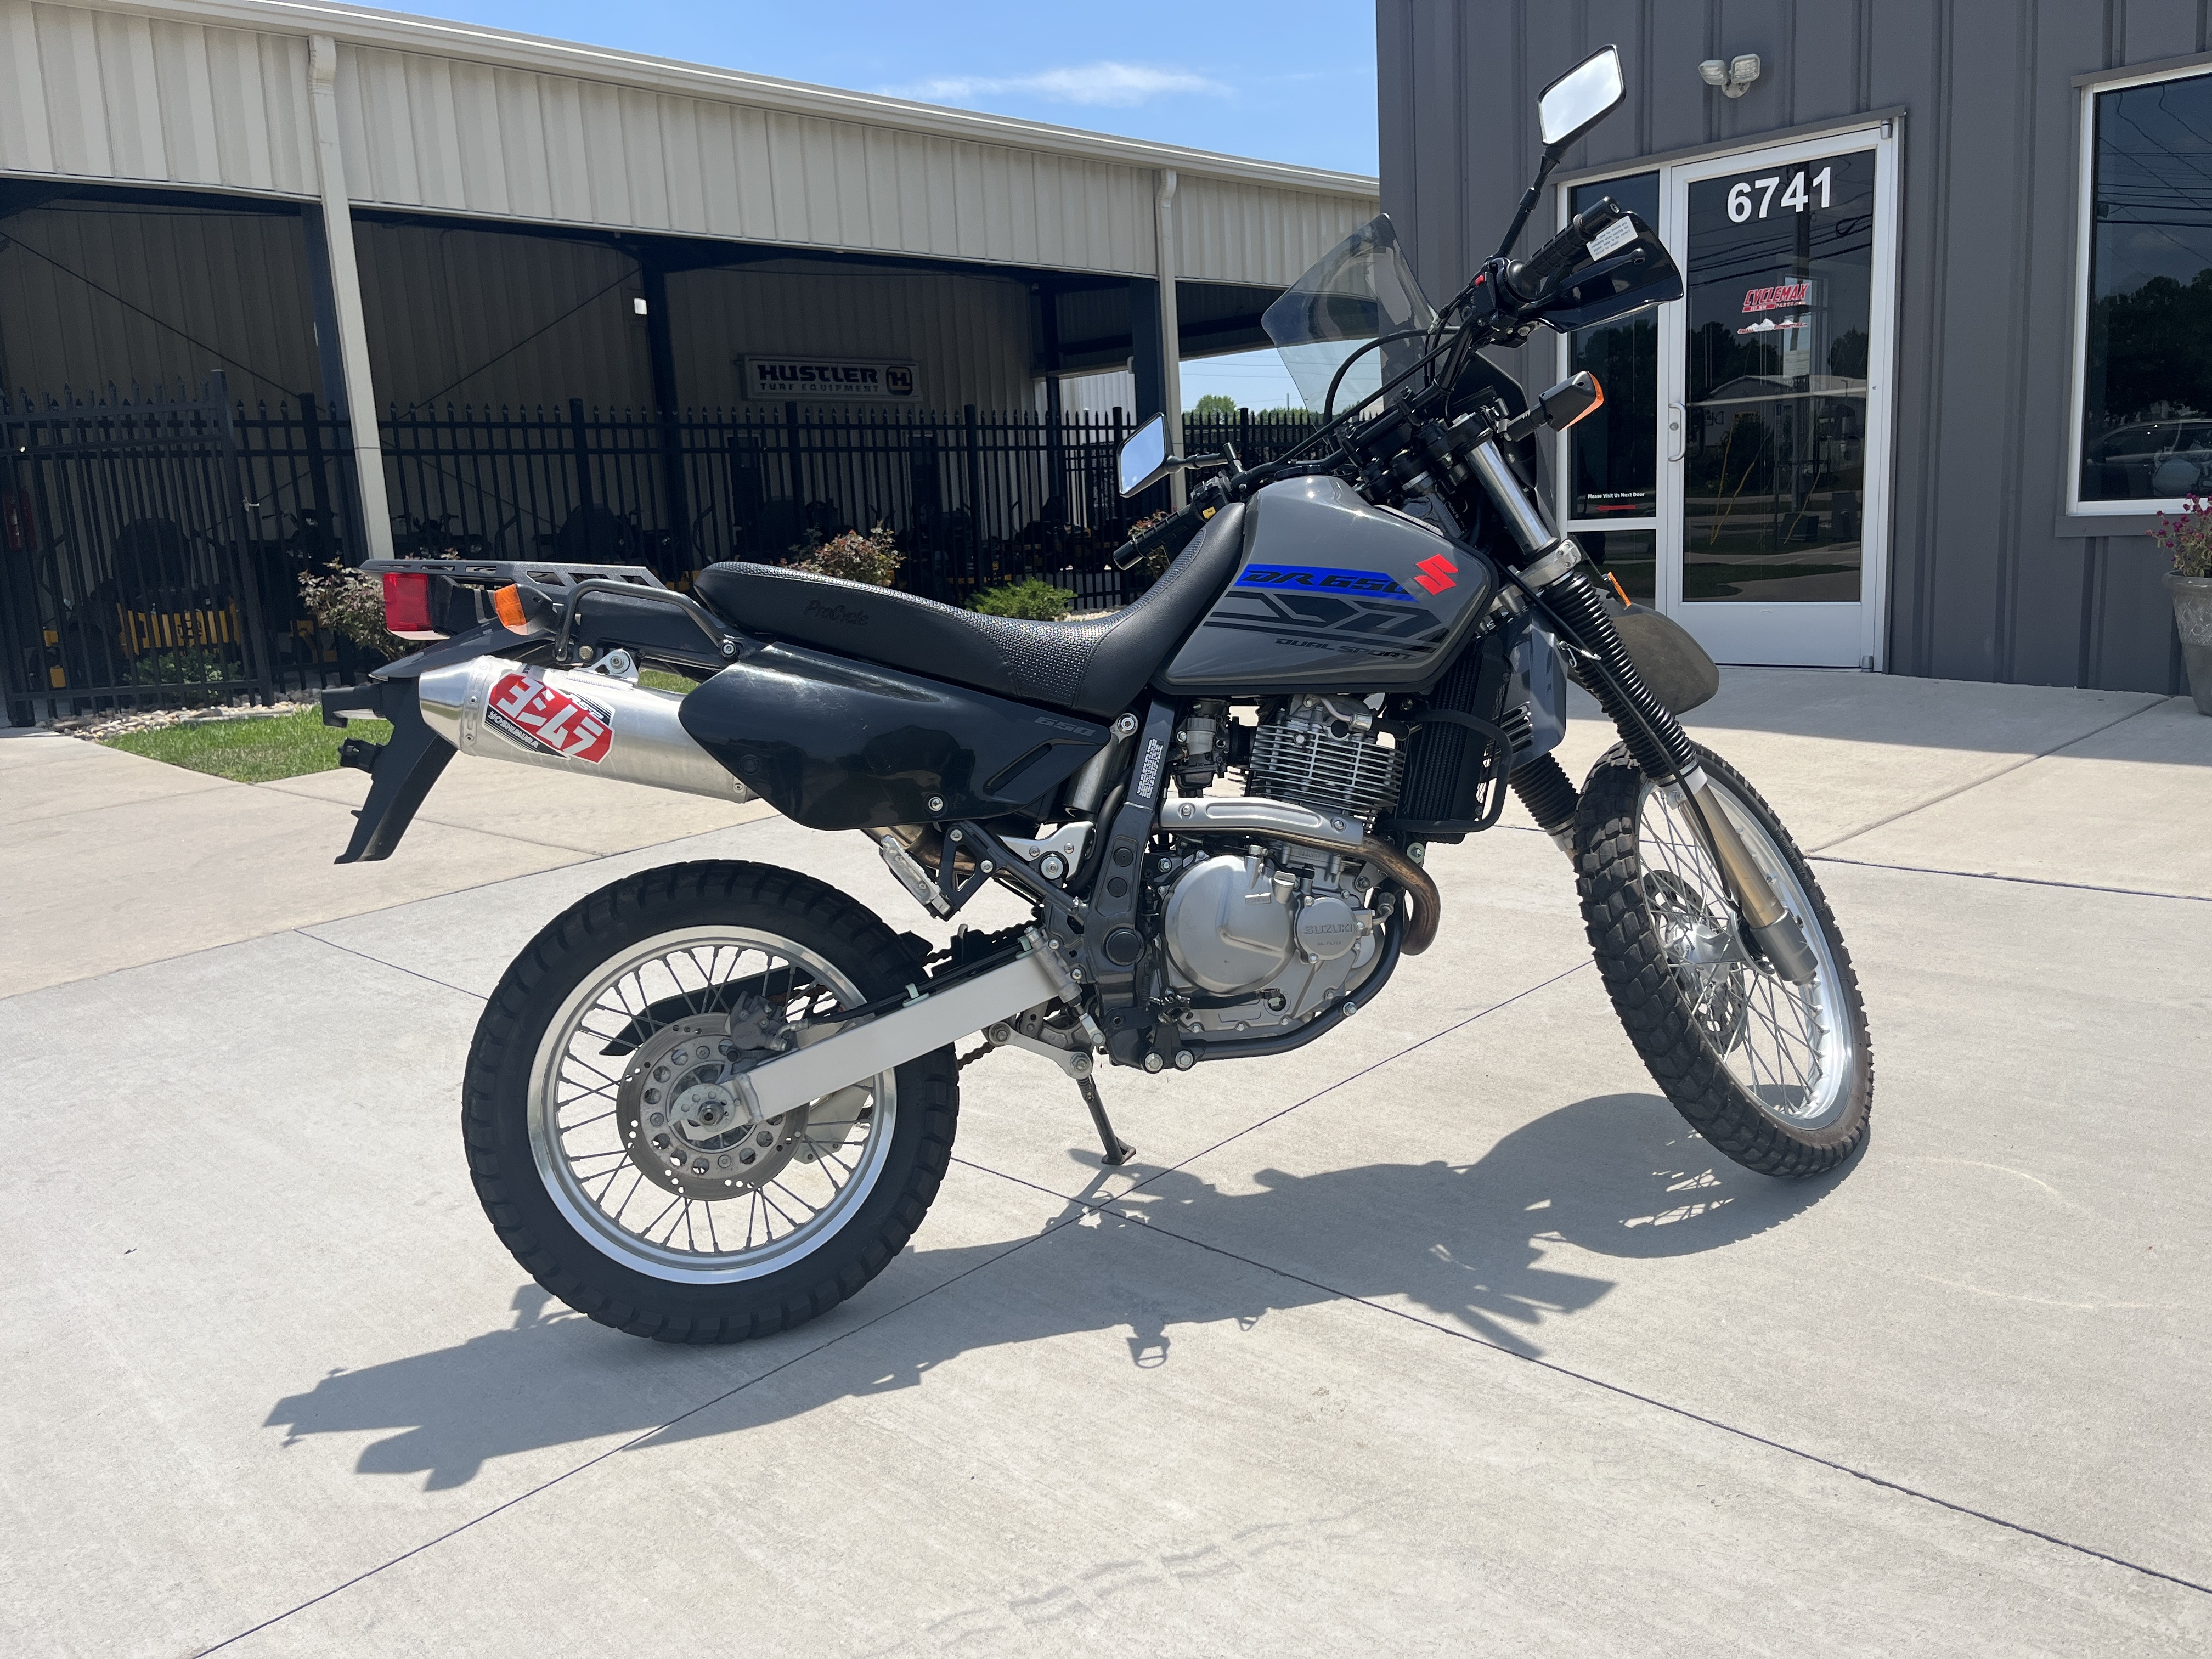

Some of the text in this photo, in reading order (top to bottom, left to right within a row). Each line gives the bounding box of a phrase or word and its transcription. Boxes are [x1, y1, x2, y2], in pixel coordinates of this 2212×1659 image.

[1728, 167, 1830, 223] 6741
[1743, 283, 1809, 306] CYCLEMAX
[758, 365, 878, 383] HUSTLER
[802, 384, 879, 392] EQUIPMENT
[1240, 570, 1315, 586] DR
[804, 600, 869, 626] ProCycle
[1274, 637, 1417, 660] DUAL SPORT
[496, 676, 605, 755] ヨシムラ
[1034, 716, 1097, 737] 650
[487, 710, 539, 748] YOSHIMURA
[1303, 924, 1353, 935] SUZUKI
